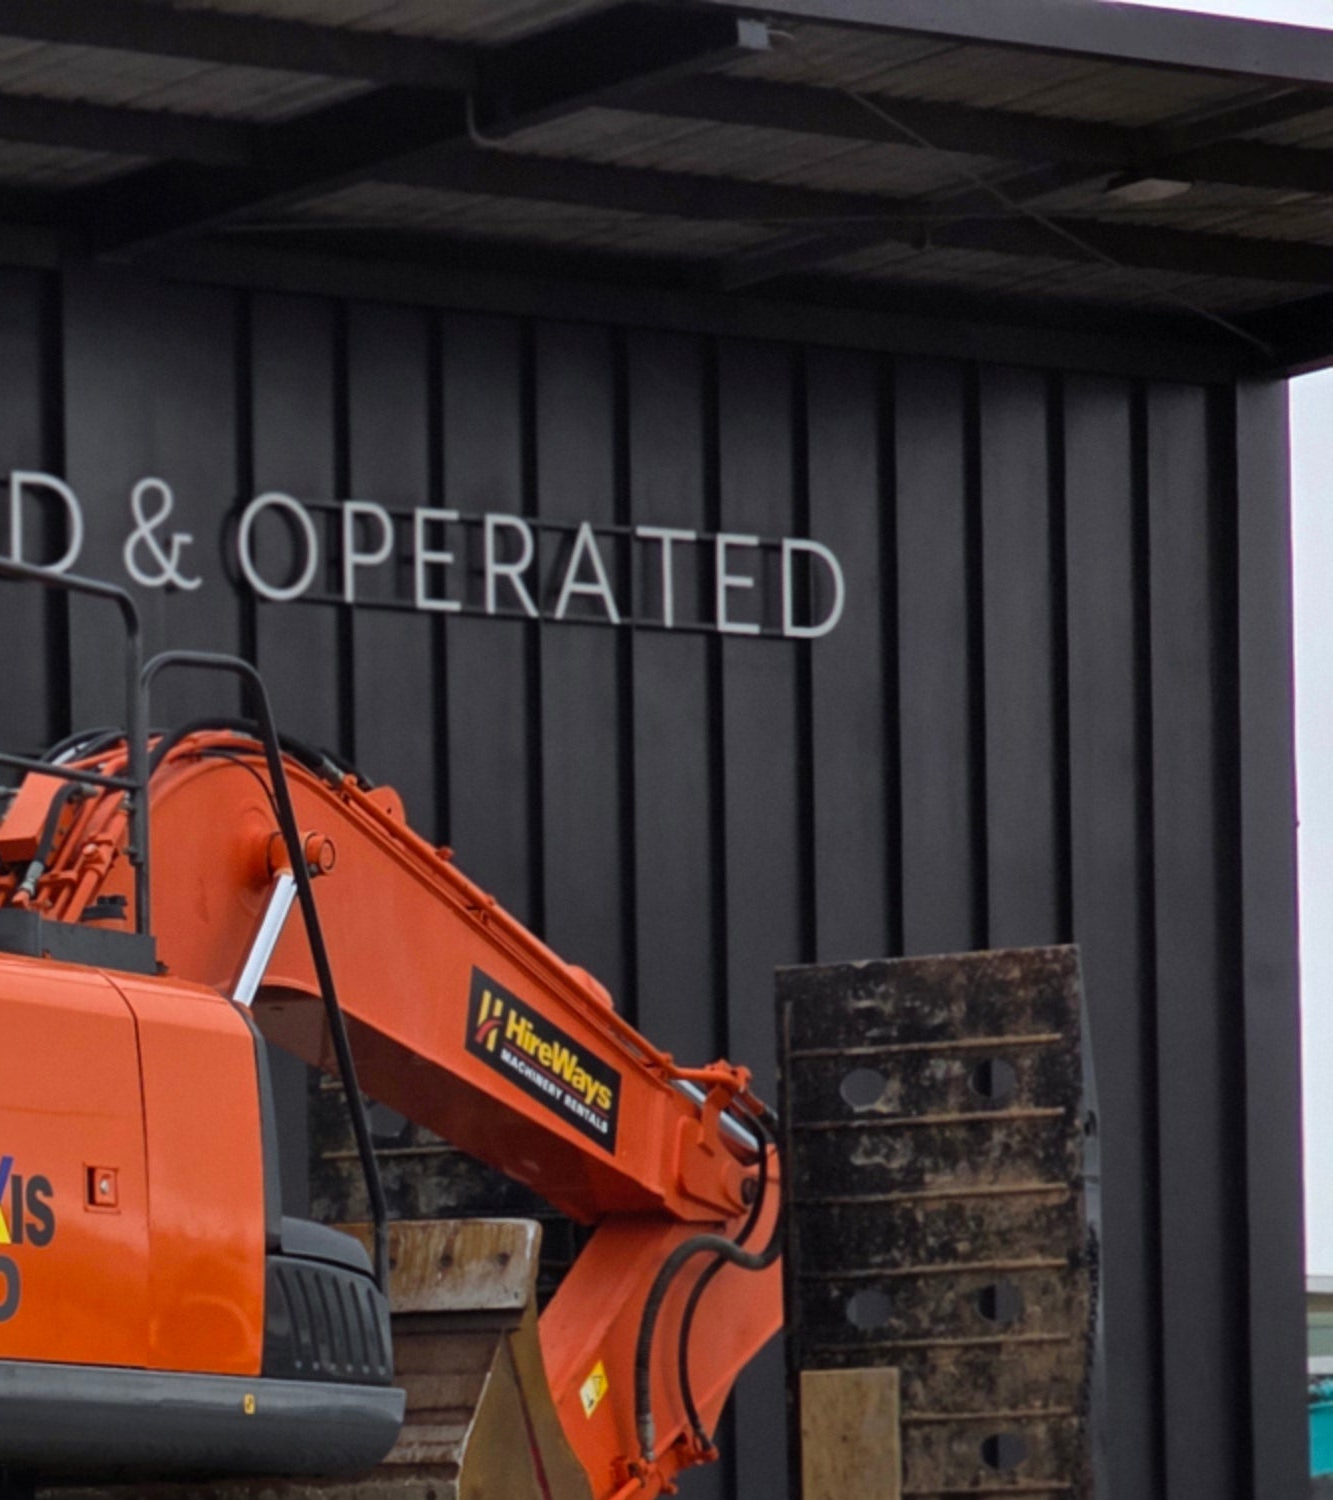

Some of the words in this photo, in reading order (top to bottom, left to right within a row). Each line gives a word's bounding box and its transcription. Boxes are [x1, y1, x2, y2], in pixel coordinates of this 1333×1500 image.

[124, 478, 203, 589] &
[237, 492, 845, 640] OPERATED
[500, 1048, 563, 1101] MACHINERY
[563, 1094, 608, 1134] RENTALS
[505, 1009, 612, 1111] HireWays
